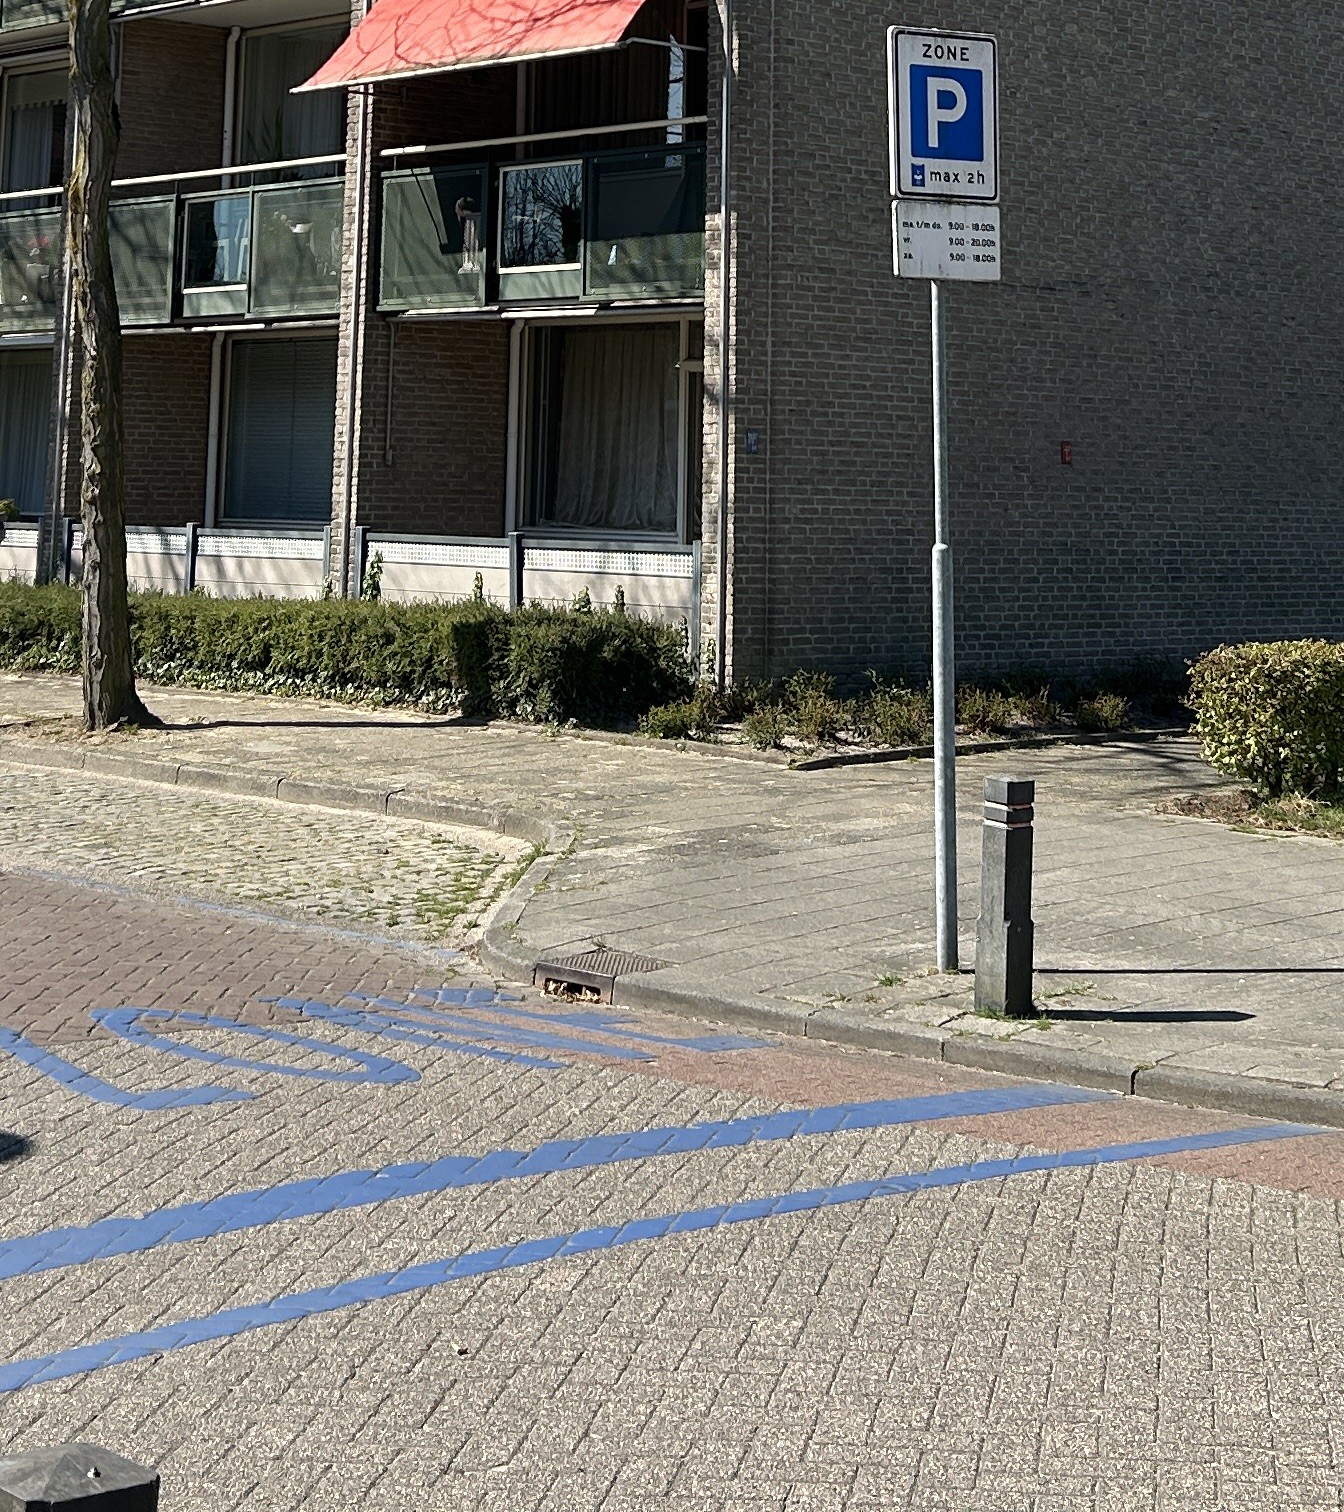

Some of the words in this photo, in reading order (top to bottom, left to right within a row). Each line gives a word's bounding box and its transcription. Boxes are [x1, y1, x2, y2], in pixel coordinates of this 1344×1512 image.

[922, 43, 970, 61] ZONE
[927, 76, 967, 148] P
[929, 170, 961, 184] max
[967, 170, 985, 185] 2h
